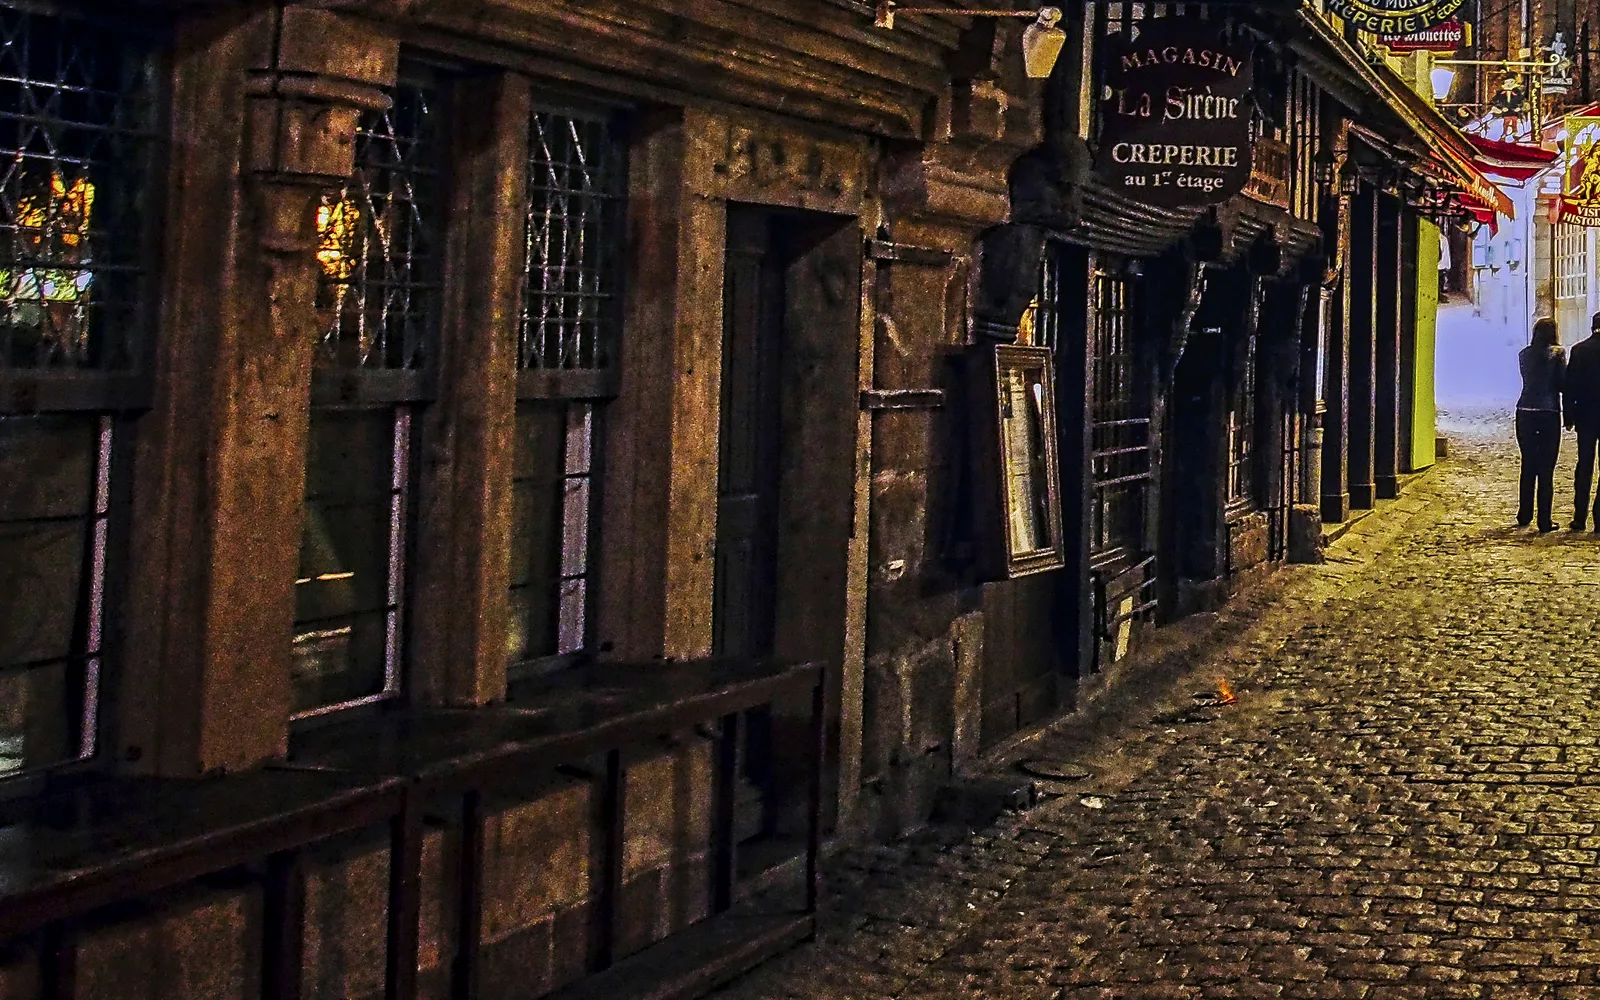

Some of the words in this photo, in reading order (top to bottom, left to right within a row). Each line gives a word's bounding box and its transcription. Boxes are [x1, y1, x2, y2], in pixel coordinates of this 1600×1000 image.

[1120, 46, 1243, 78] MAGASIN
[1115, 88, 1152, 118] La
[1161, 85, 1240, 125] Sirène
[1112, 142, 1238, 168] CREPERIE
[1124, 173, 1146, 186] au
[1176, 172, 1224, 193] étage
